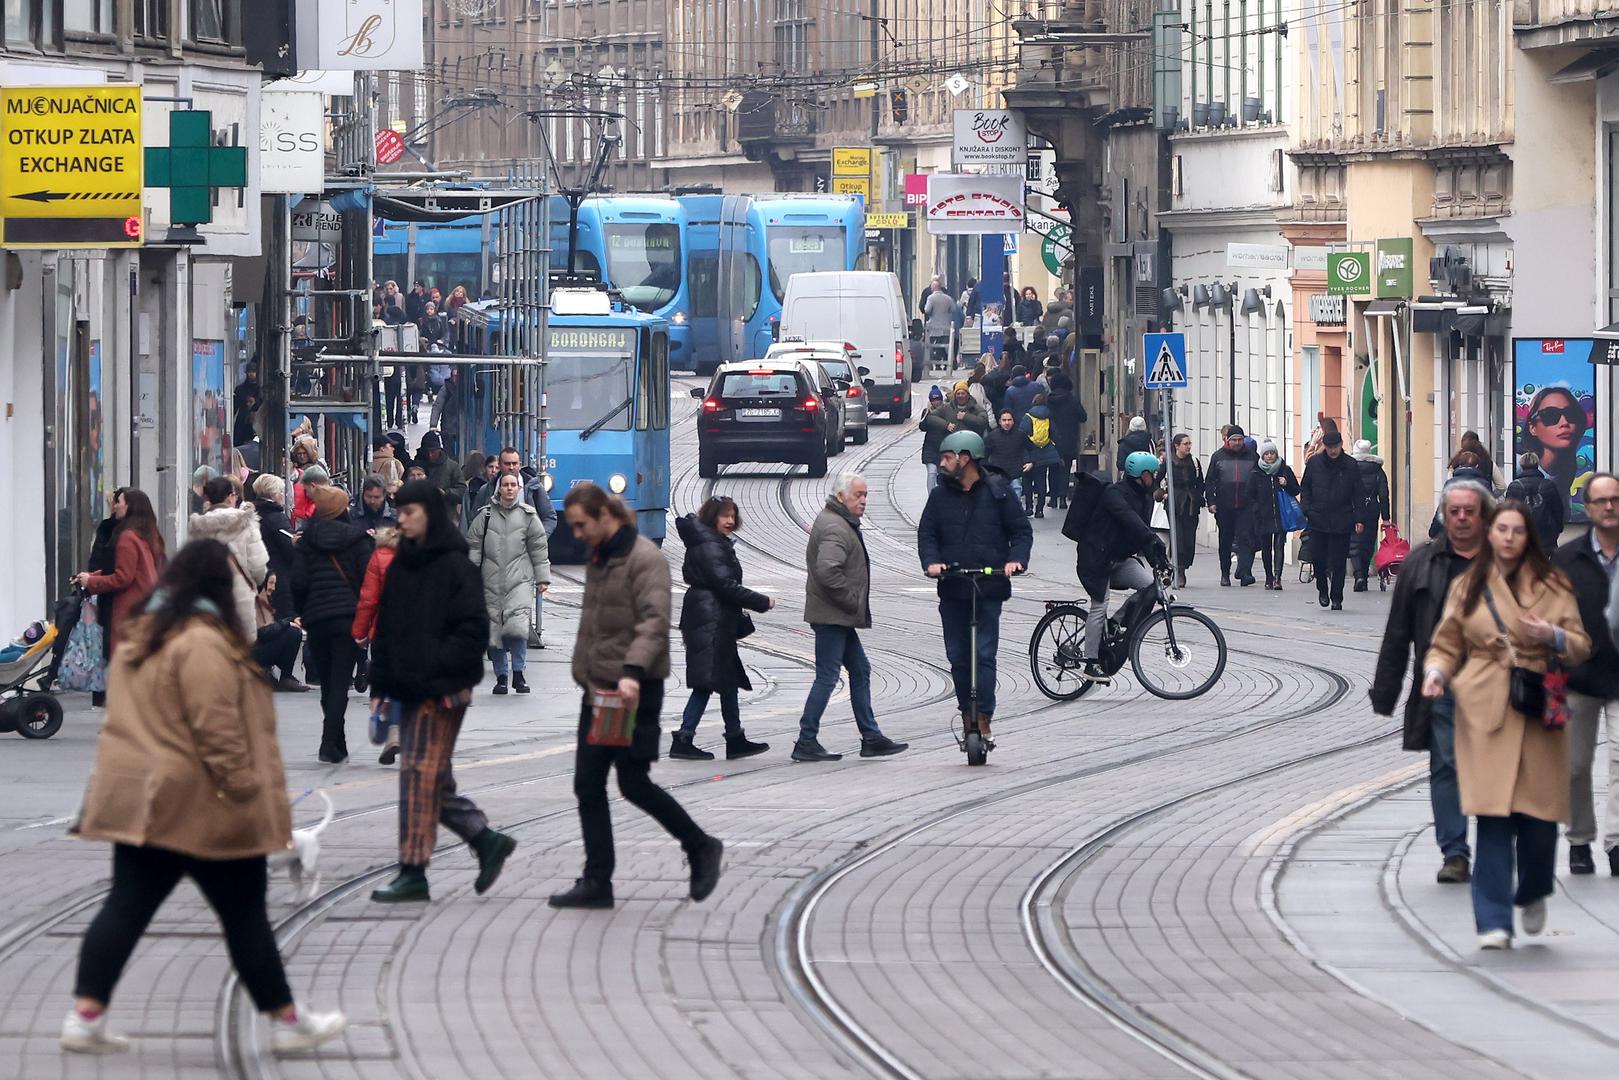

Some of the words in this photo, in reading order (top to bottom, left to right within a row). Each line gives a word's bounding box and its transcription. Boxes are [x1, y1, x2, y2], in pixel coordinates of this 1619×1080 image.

[971, 112, 1010, 131] Book
[8, 129, 74, 145] OTKUP
[79, 129, 136, 145] ZLATA
[981, 129, 1000, 137] STOP
[959, 145, 990, 153] KNJIŽARA
[20, 157, 125, 173] EXCHANGE
[907, 193, 928, 204] BIP
[551, 332, 626, 348] BORONGAJ
